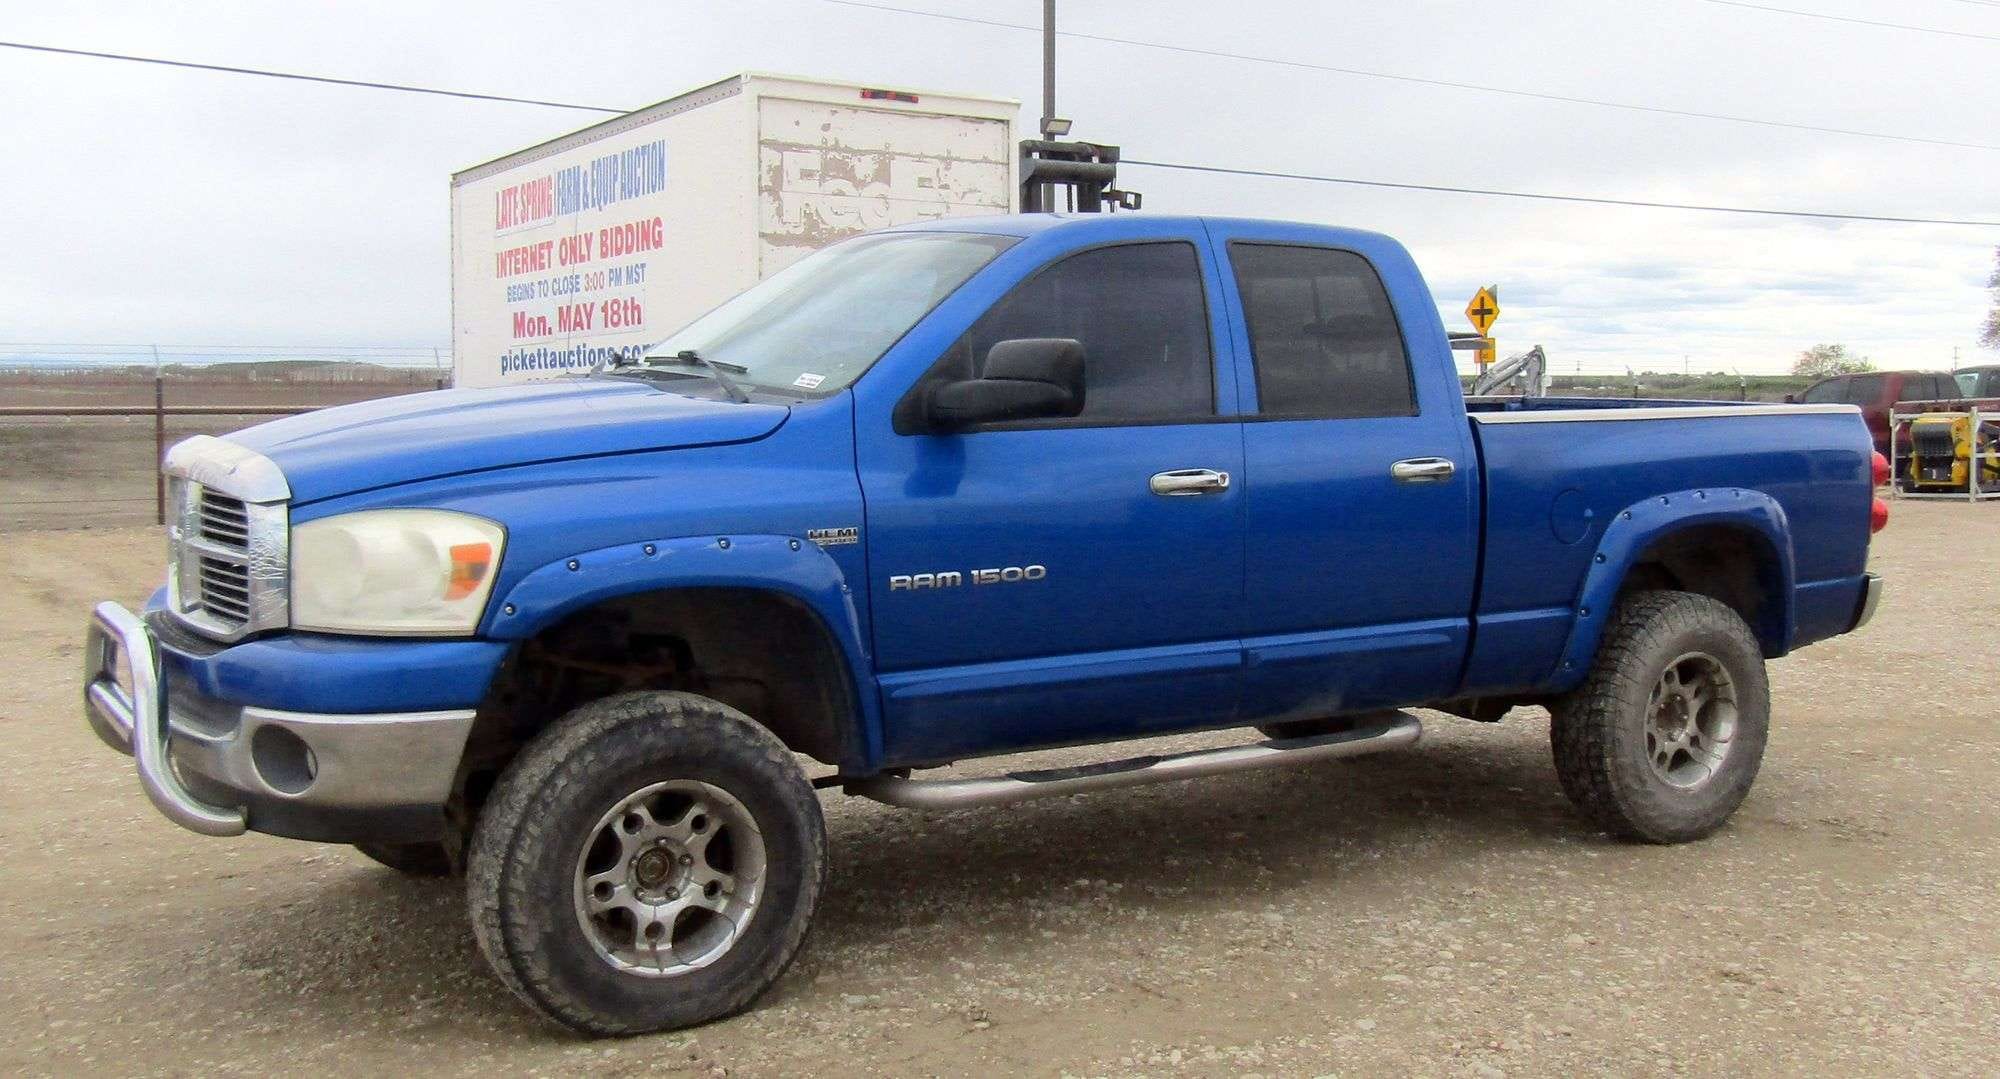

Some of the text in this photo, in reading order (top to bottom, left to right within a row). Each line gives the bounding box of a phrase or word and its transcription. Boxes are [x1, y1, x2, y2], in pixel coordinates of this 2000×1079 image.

[495, 139, 666, 230] LATE SPRING FARM & EQUIP AUCTION
[496, 216, 664, 278] INTERNET ONLY BIDDING
[507, 262, 647, 303] BEGINS TO CLOSE 3:00 PM MST
[513, 296, 642, 339] Mon. MAY 18th
[890, 565, 1046, 592] RAM 1500
